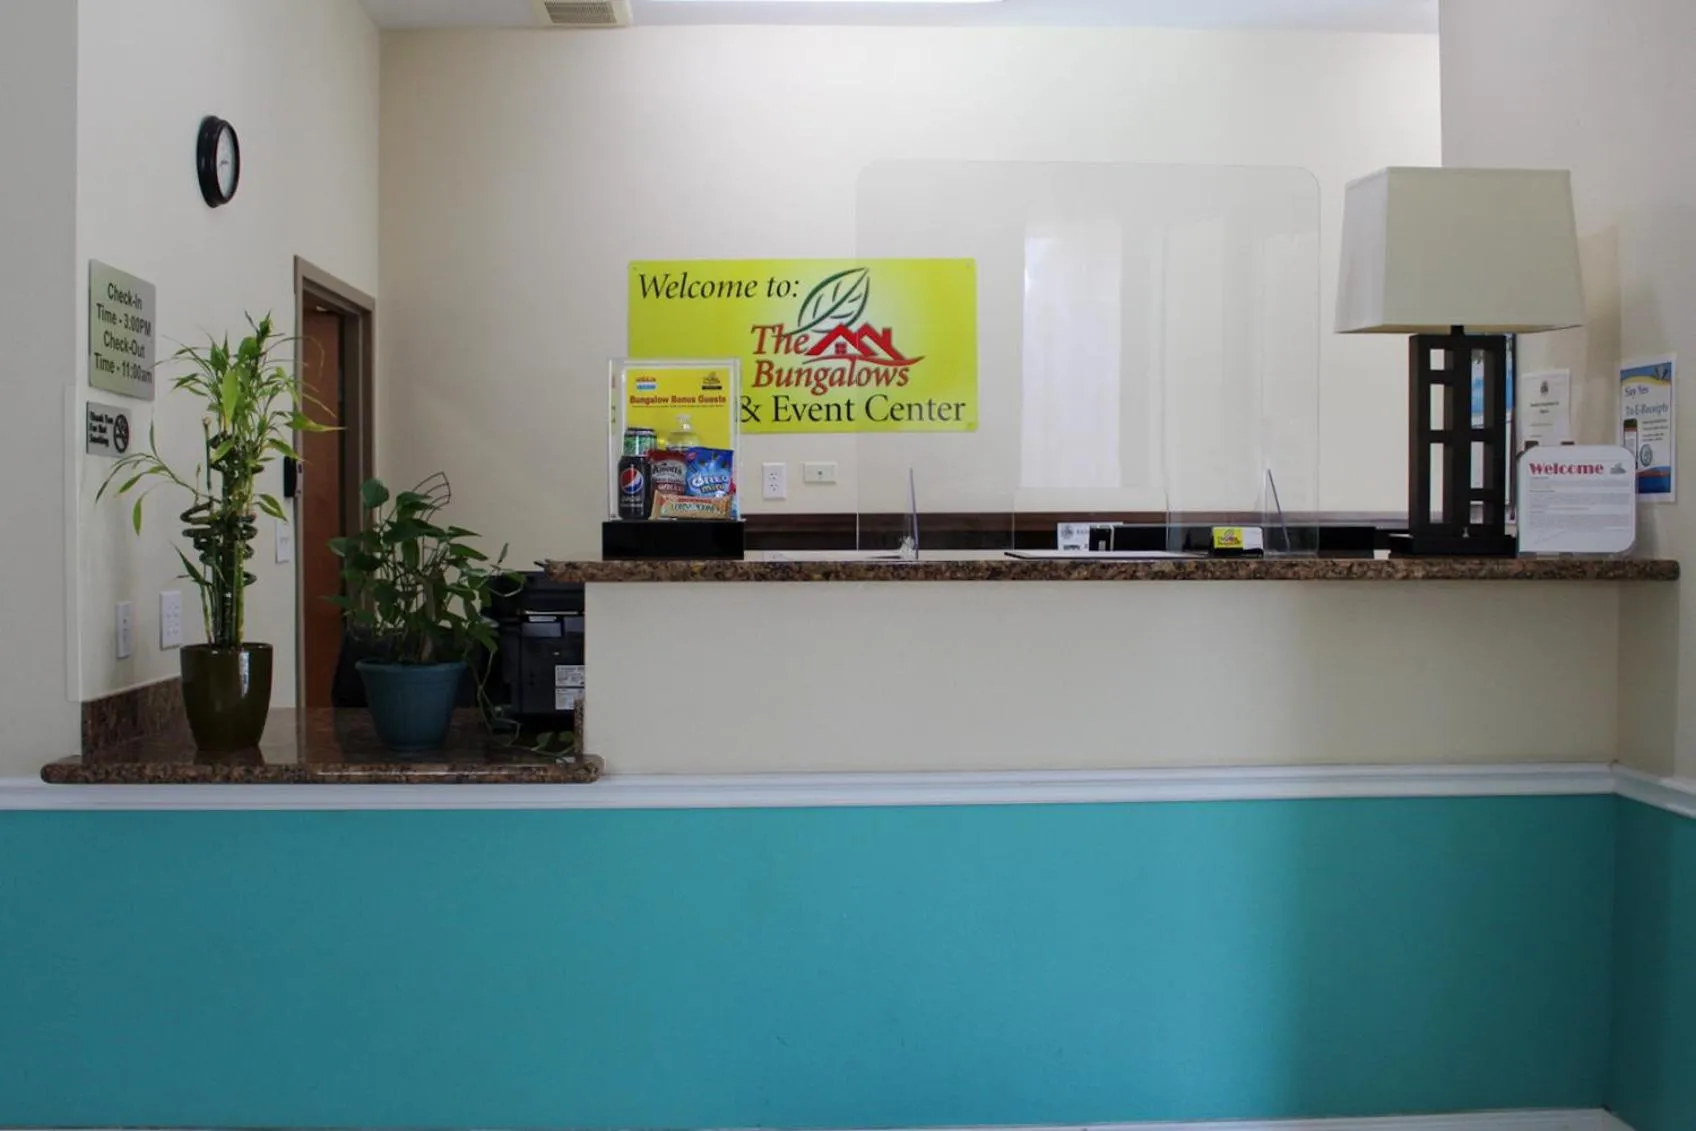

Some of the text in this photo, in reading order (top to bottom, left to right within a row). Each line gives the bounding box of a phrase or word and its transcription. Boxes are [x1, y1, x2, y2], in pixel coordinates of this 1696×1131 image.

[107, 282, 143, 310] Check-In
[639, 273, 800, 299] Welcome to:
[96, 302, 117, 325] Time
[103, 329, 146, 359] Check-Out
[751, 322, 811, 356] The
[94, 352, 115, 374] Time
[752, 358, 910, 397] Bungalows
[629, 395, 669, 405] Bungalow
[671, 395, 696, 403] Bonus
[772, 394, 854, 422] Event
[864, 394, 967, 422] Center
[1529, 462, 1604, 475] Welcome
